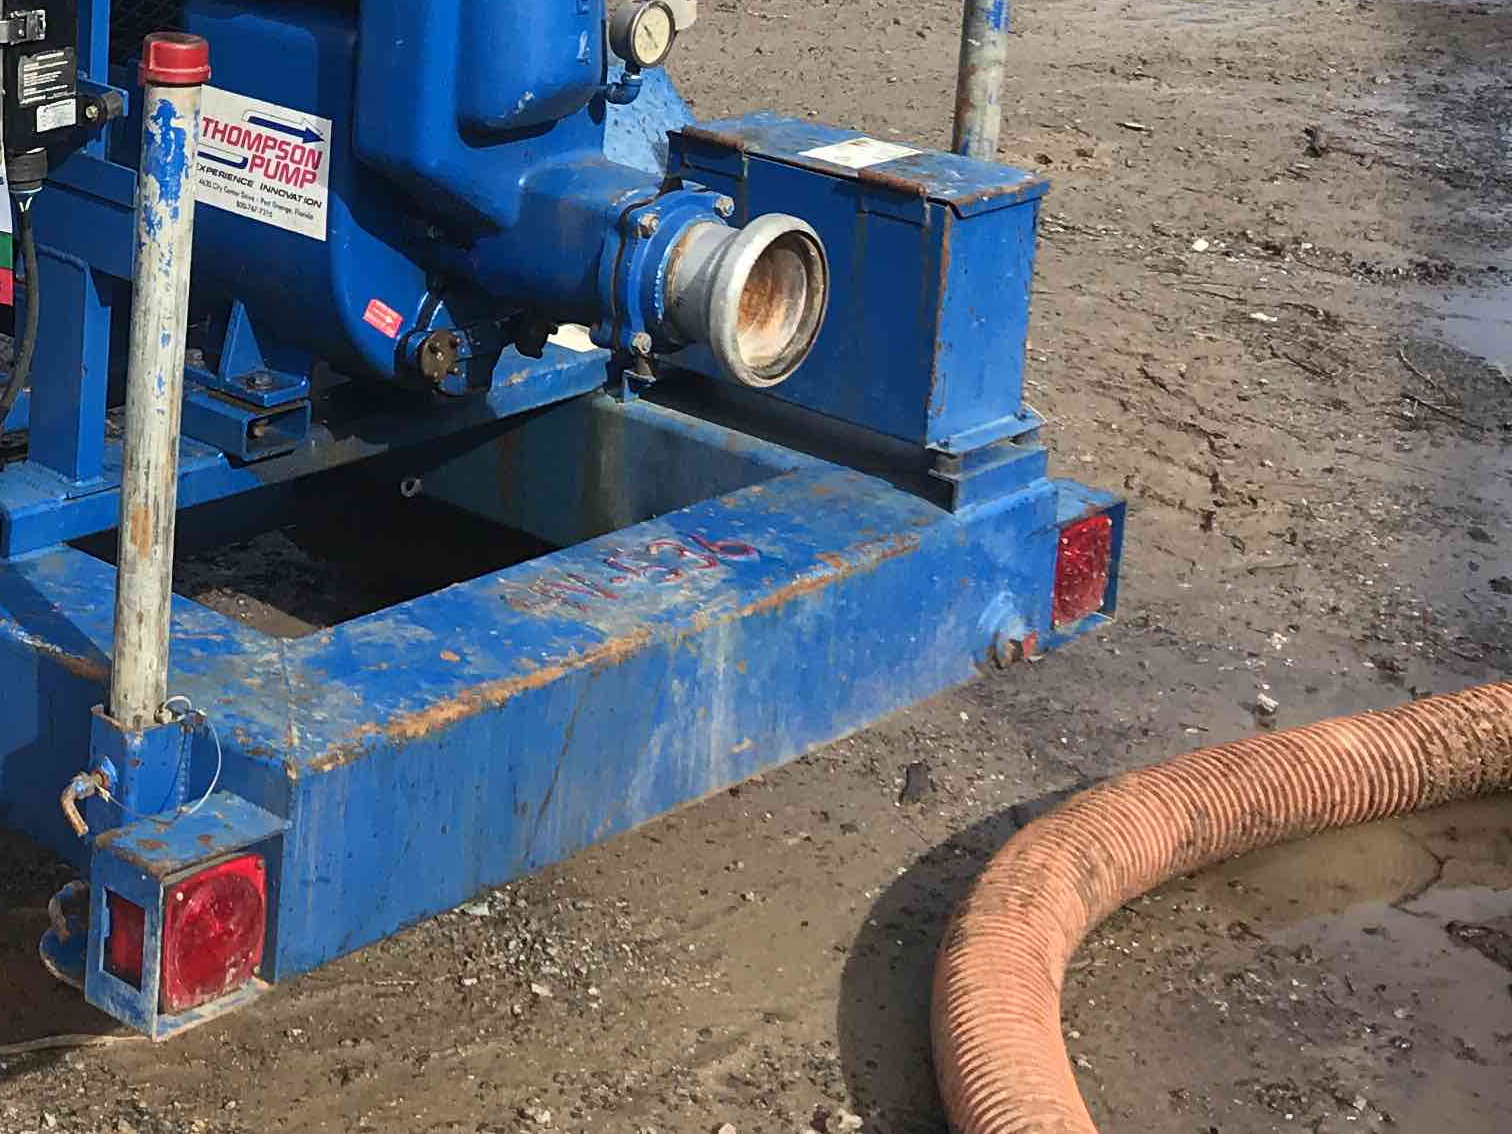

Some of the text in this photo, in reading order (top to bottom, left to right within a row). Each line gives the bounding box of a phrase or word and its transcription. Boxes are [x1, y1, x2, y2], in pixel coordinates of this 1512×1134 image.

[202, 116, 323, 171] THOMPSON
[248, 153, 317, 189] PUMP
[260, 182, 323, 208] INNOVATION
